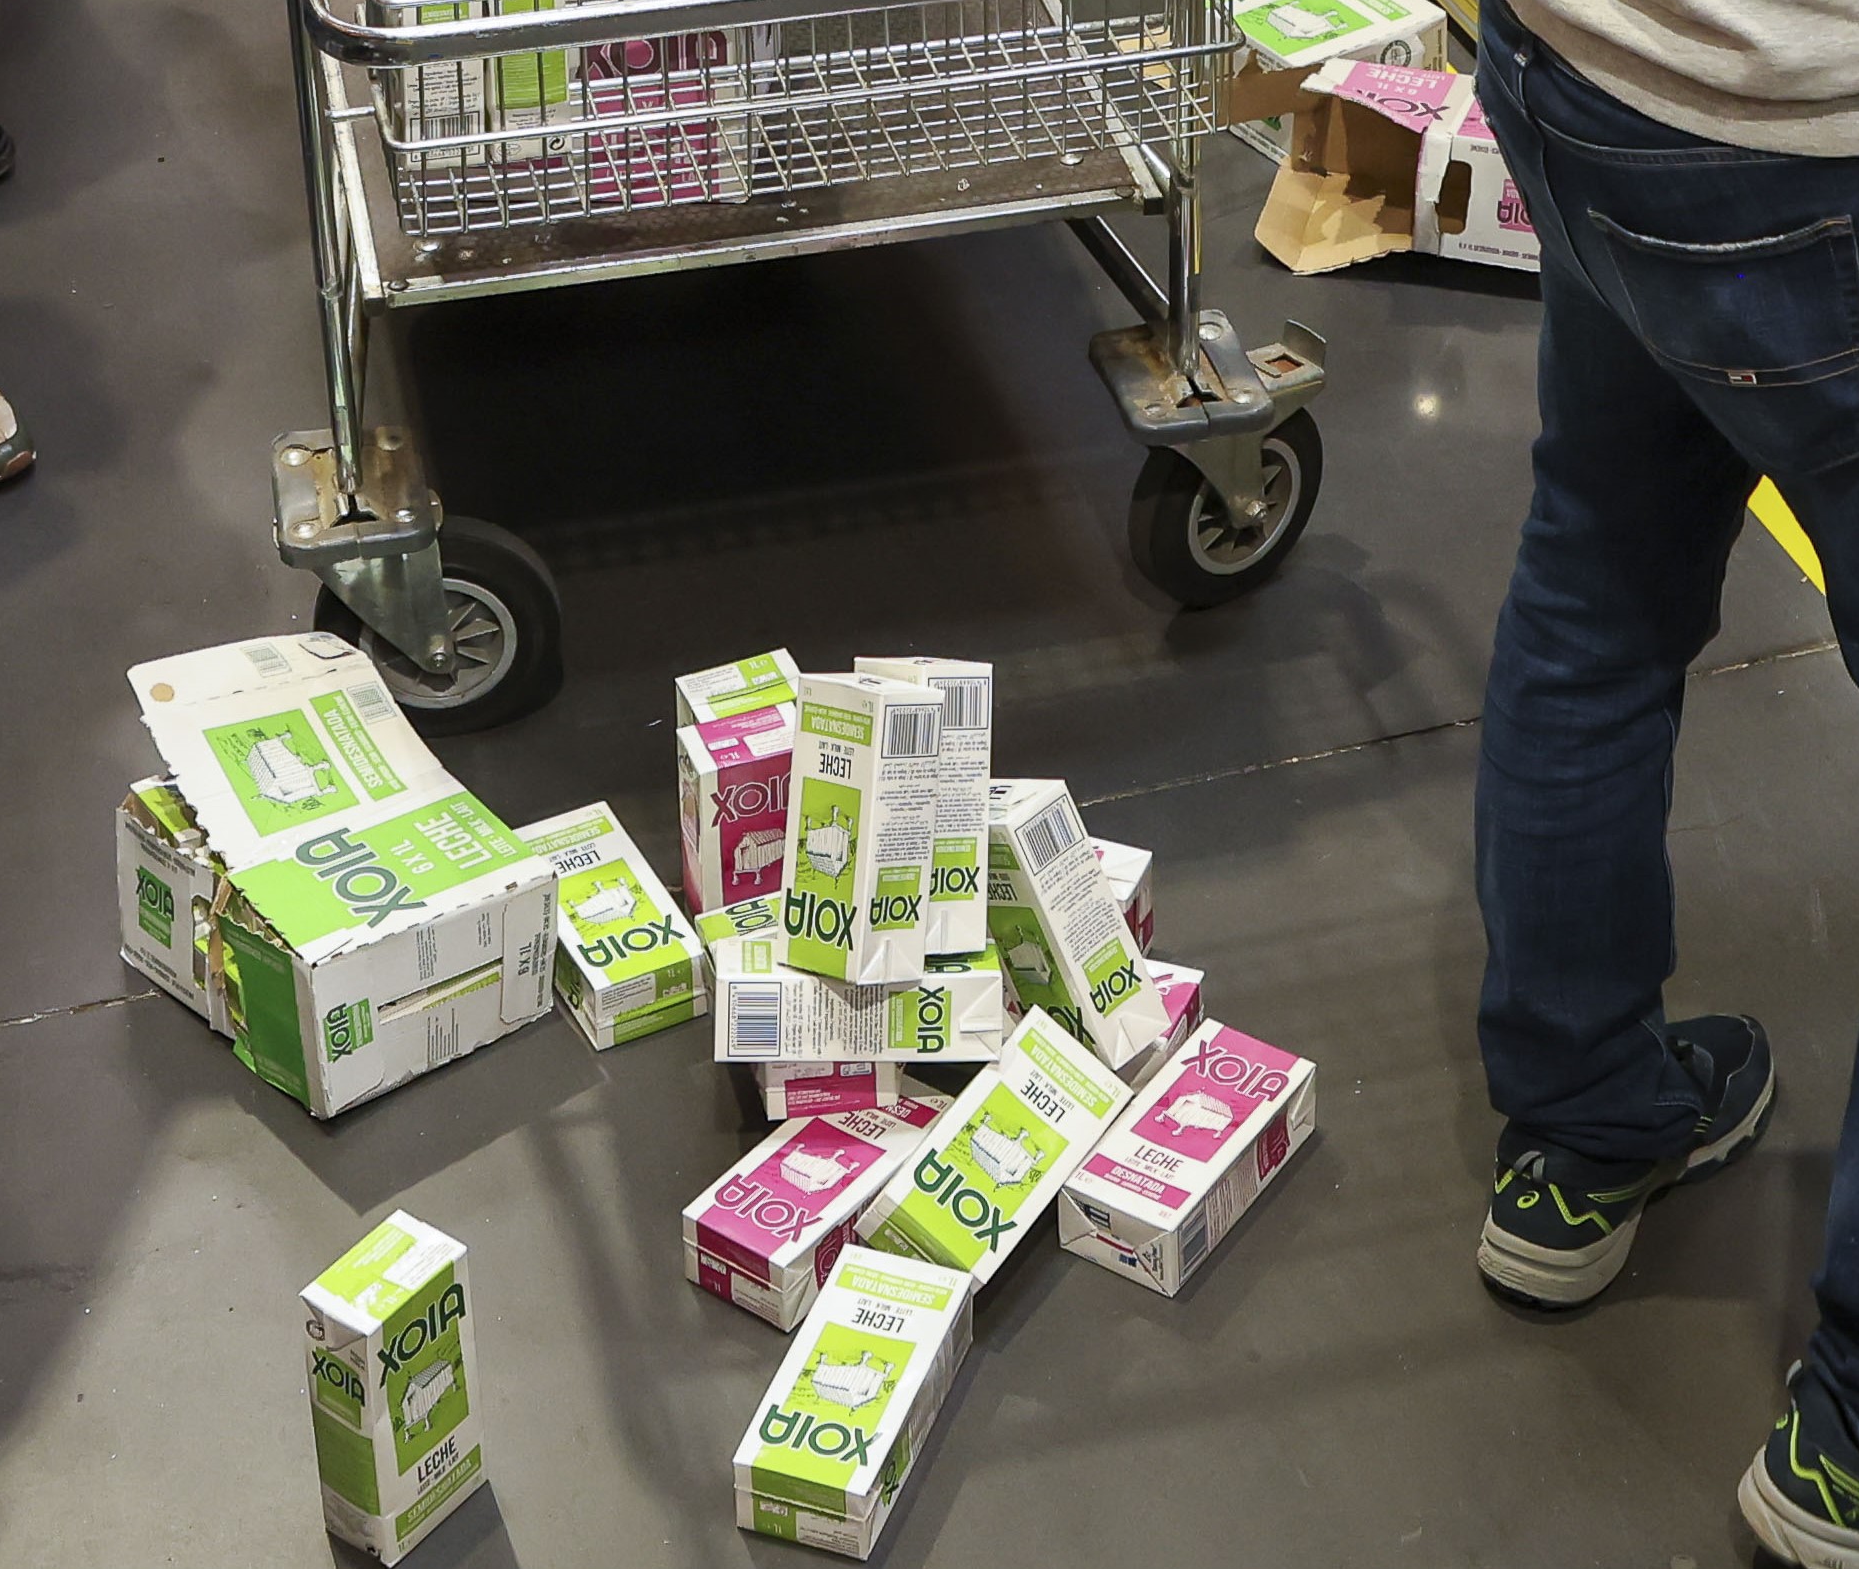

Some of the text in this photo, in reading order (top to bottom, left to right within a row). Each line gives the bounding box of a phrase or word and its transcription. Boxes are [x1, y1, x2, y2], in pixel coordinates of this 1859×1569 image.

[1366, 67, 1442, 90] LECHE
[818, 753, 852, 780] LECHE
[412, 812, 493, 871] LECHE
[556, 850, 603, 875] LECHE
[136, 868, 175, 923] XOIA
[295, 826, 428, 930] XOIA
[784, 887, 858, 952] XOIA
[869, 894, 922, 928] XOIA
[576, 913, 686, 969] XOIA
[1089, 957, 1143, 1015] XOIA
[325, 1001, 353, 1064] XOIA
[916, 985, 946, 1055] XOIA
[1030, 1043, 1098, 1110] SEMIDESNATADA
[1180, 1038, 1290, 1104] XOIA
[838, 1109, 886, 1141] LECHE
[1019, 1076, 1067, 1125] LECHE
[1133, 1143, 1185, 1174] LECHE
[714, 1173, 825, 1244] XOIA
[913, 1147, 1017, 1254] XOIA
[850, 1273, 938, 1306] SEMIDESNATADA
[376, 1282, 467, 1390] XOIA
[850, 1306, 906, 1333] LECHE
[311, 1349, 367, 1409] XOIA
[416, 1434, 458, 1485] LECHE
[758, 1403, 881, 1467] XOIA
